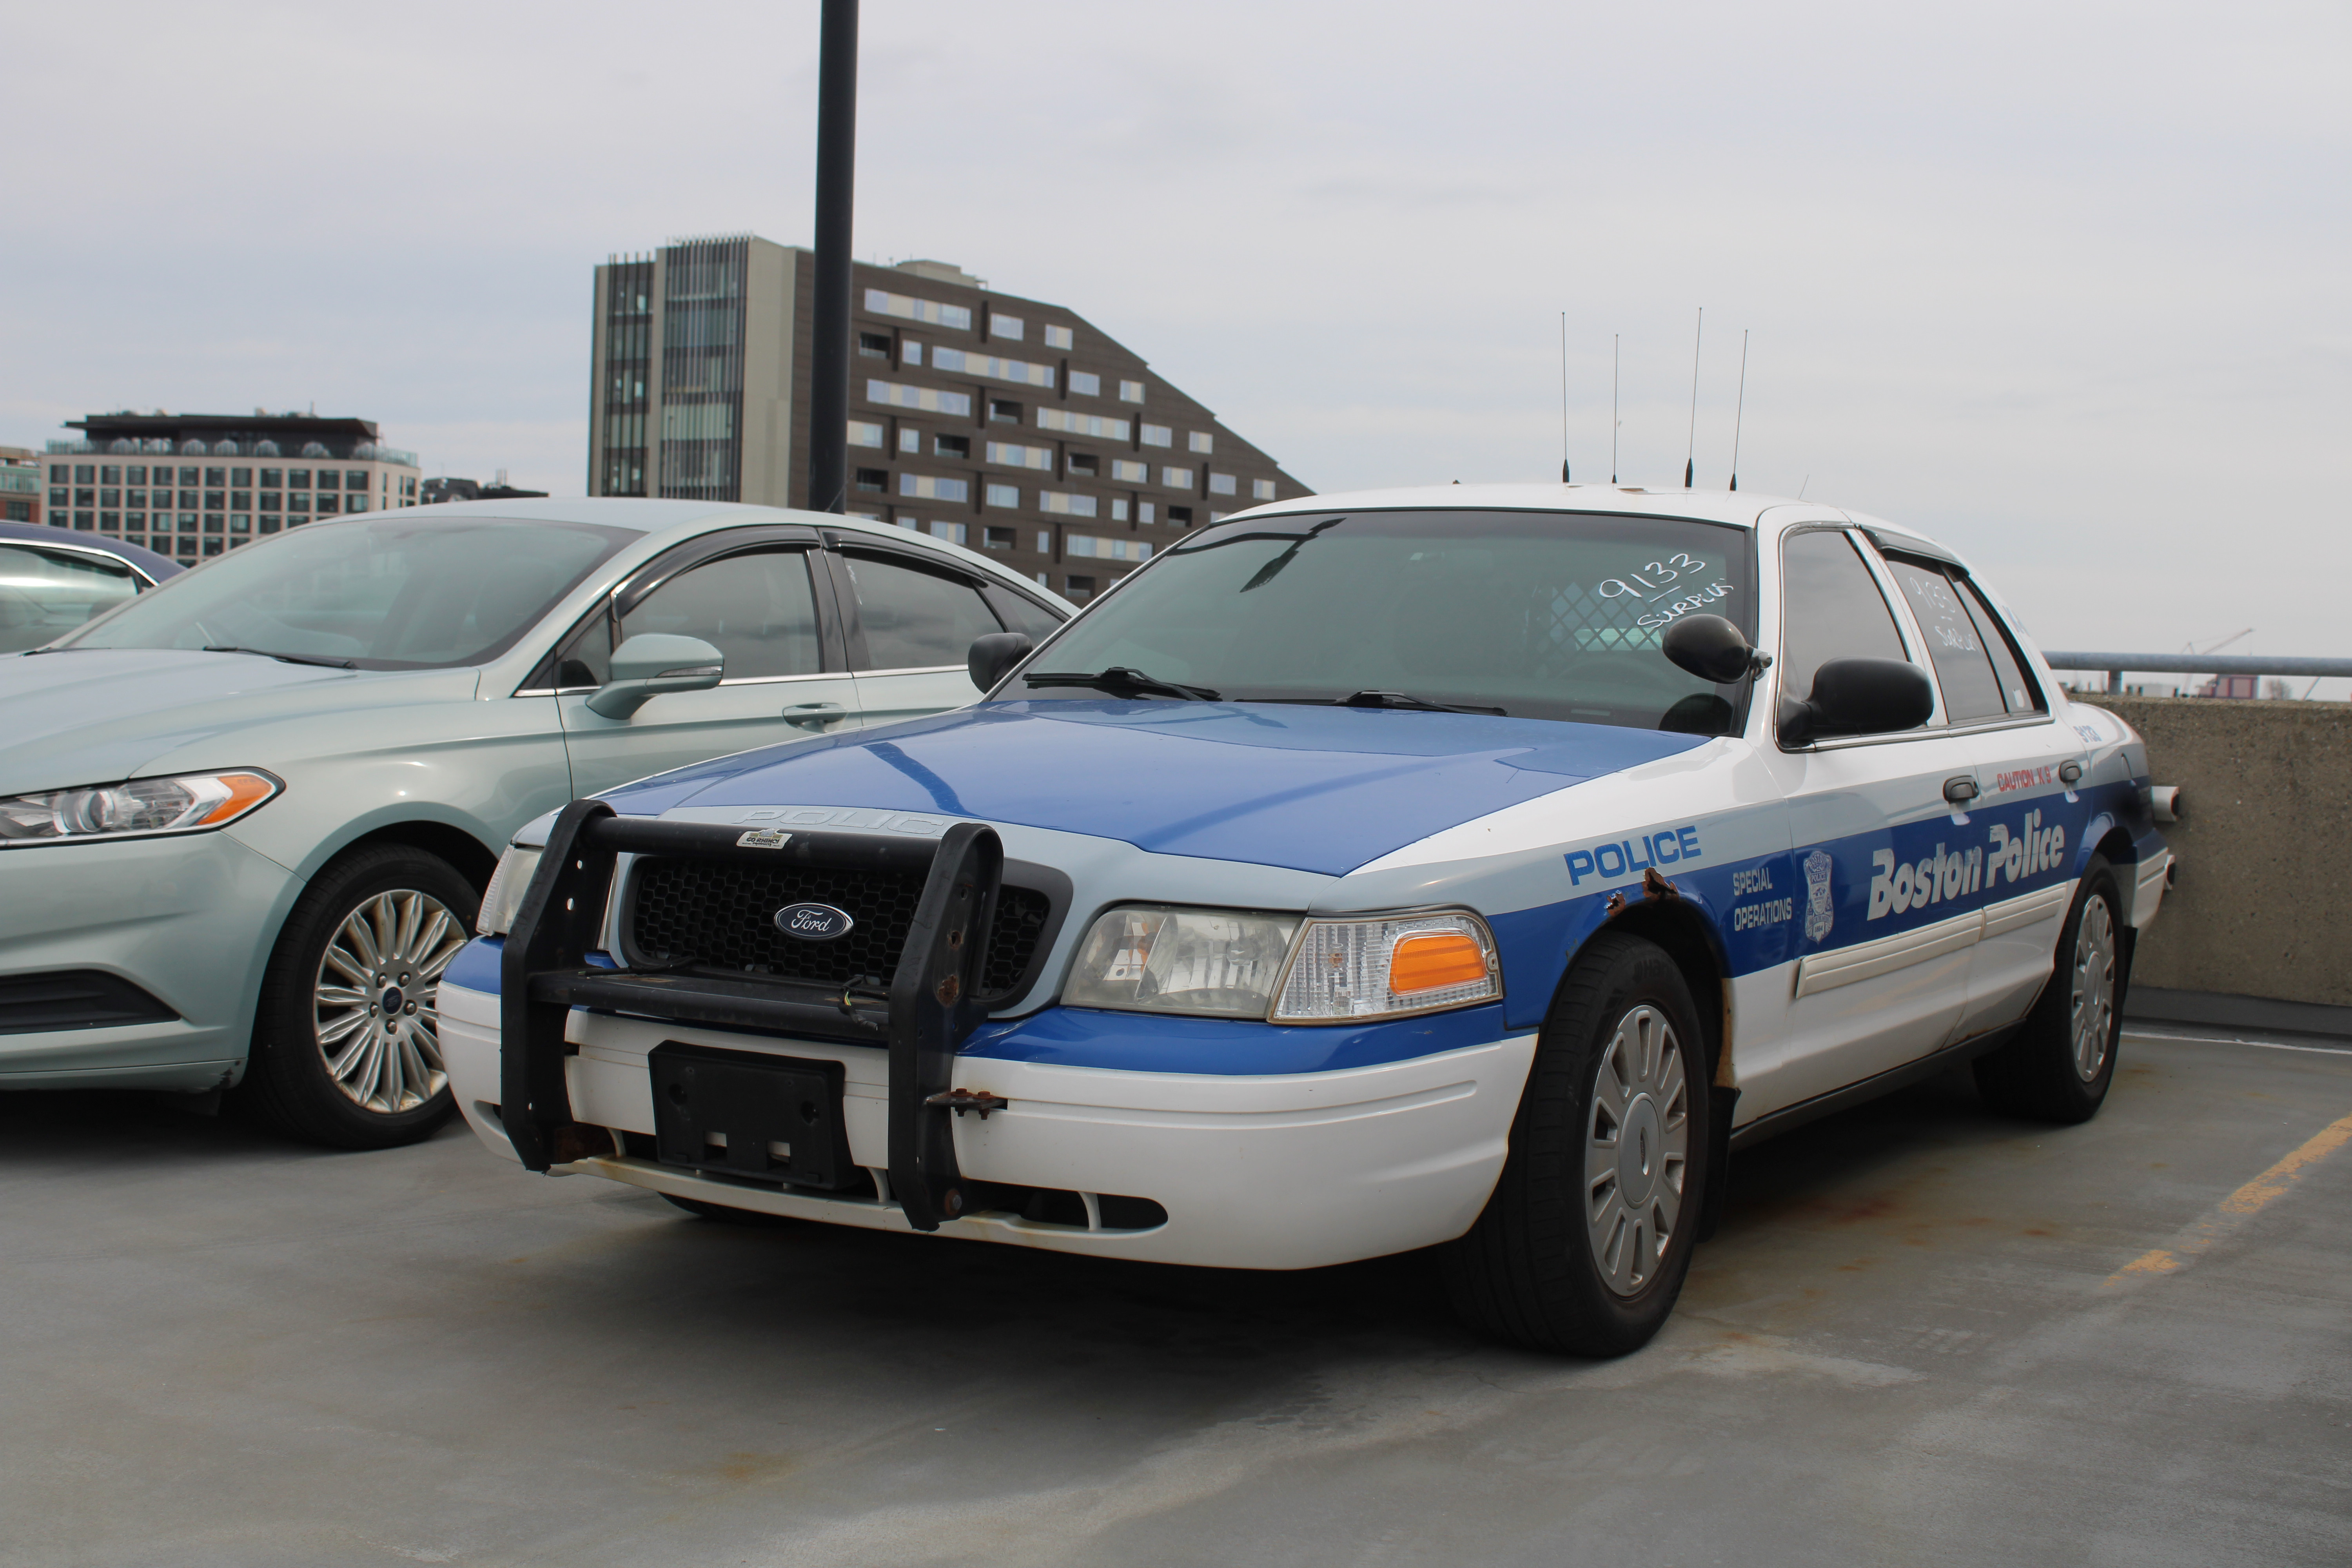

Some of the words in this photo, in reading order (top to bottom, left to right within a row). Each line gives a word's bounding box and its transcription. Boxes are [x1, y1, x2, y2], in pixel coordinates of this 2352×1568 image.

[1599, 553, 1706, 599] 9133
[1910, 577, 1955, 613] 9133
[1997, 769, 2035, 792] CAUTION
[1564, 825, 1702, 886] POLICE
[1867, 842, 1983, 921] Boston
[1985, 808, 2065, 889] Police
[1733, 867, 1773, 897] SPECIAL
[1811, 872, 1826, 882] POLICE
[791, 909, 832, 932] Ford
[1734, 897, 1792, 931] OPERATIONS
